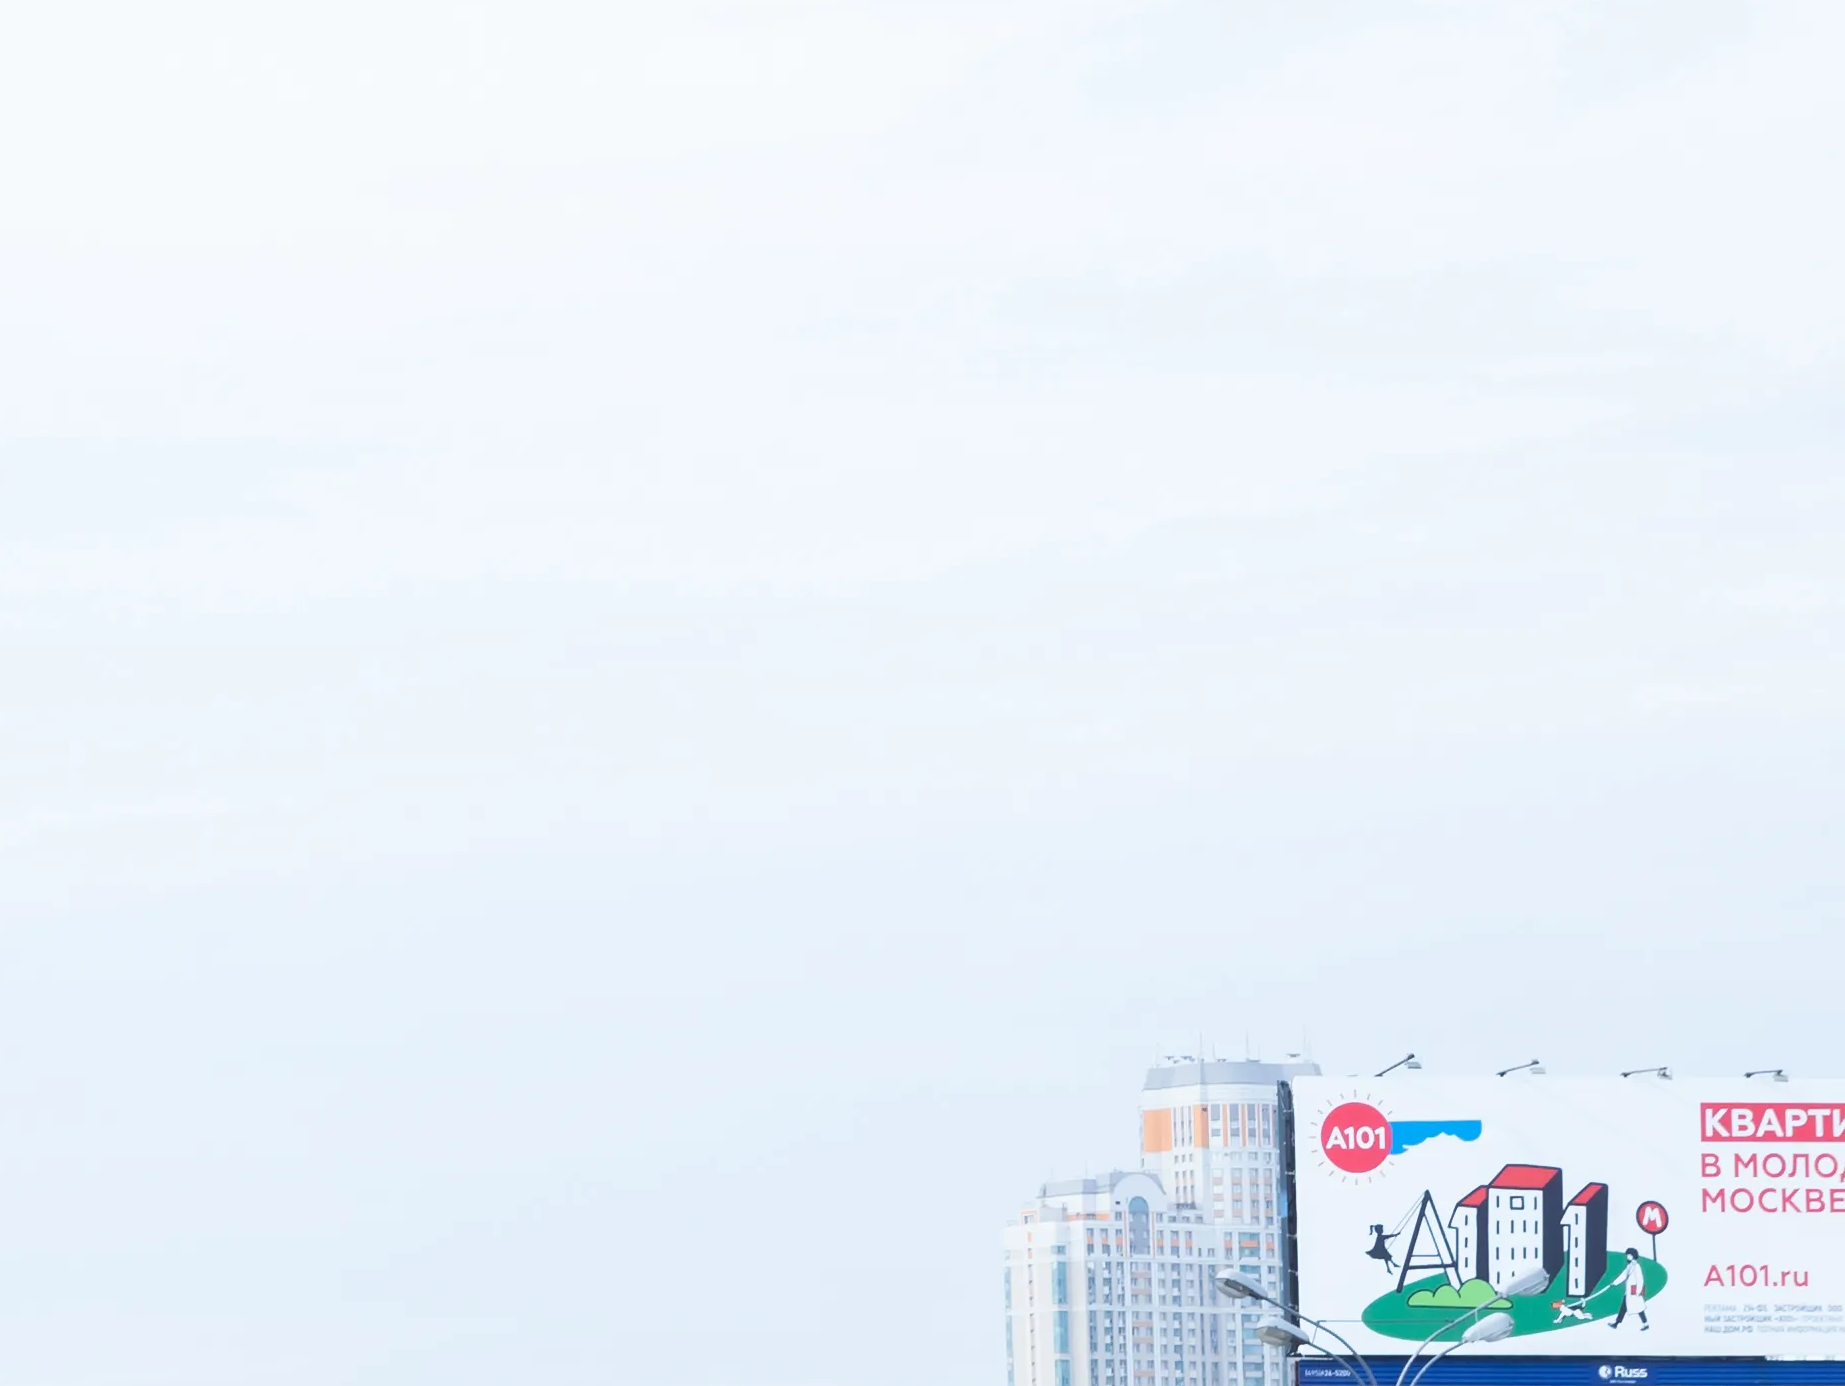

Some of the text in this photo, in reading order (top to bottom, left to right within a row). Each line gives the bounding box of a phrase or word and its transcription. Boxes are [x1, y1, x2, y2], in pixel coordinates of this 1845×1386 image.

[1701, 1152, 1845, 1181] В МОЛО
[1702, 1187, 1845, 1213] МОСКВЕ
[1614, 1365, 1648, 1378] Russ
